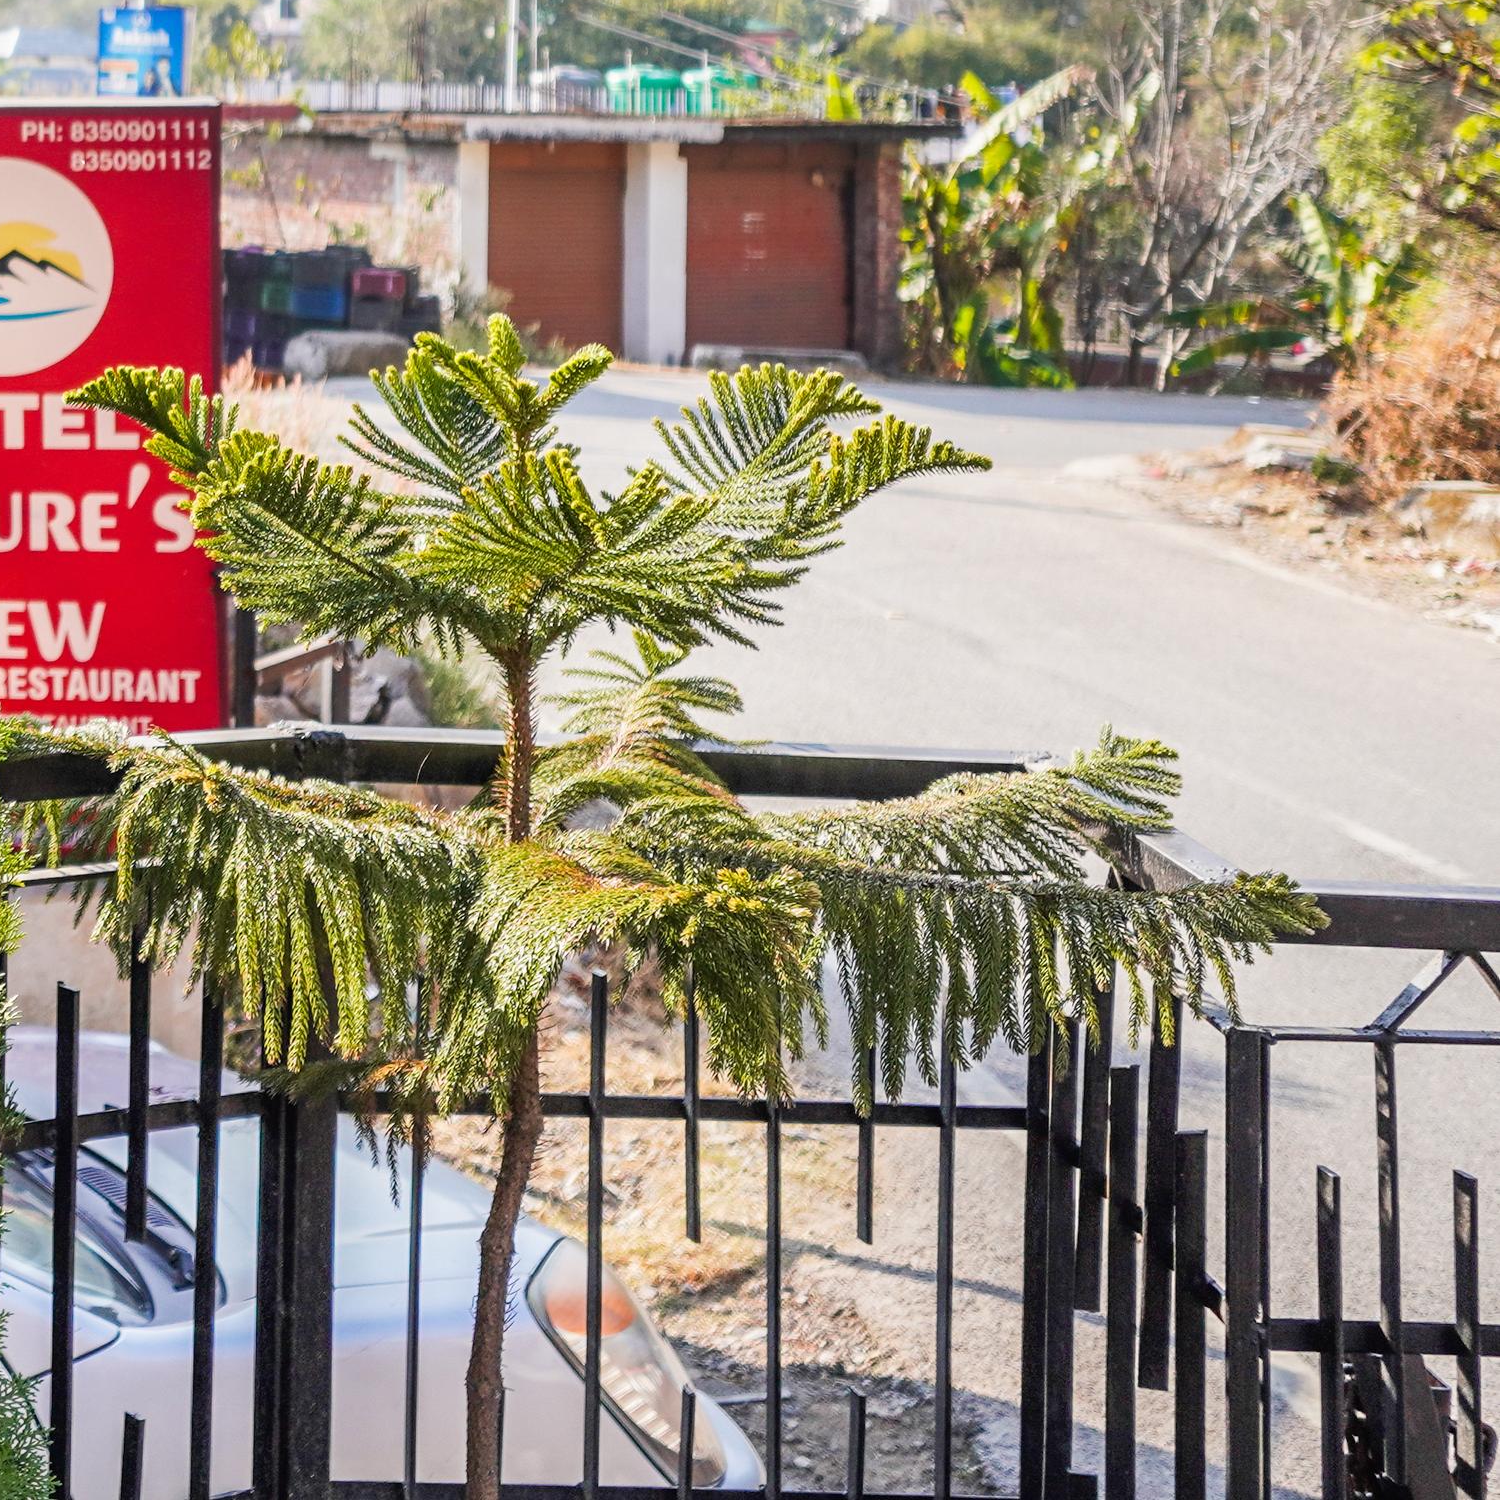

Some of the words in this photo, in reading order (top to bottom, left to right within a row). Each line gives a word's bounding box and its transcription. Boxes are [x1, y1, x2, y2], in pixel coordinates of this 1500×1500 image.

[20, 120, 63, 142] PH:
[70, 120, 210, 143] 8350901111
[70, 148, 212, 172] 8350901112
